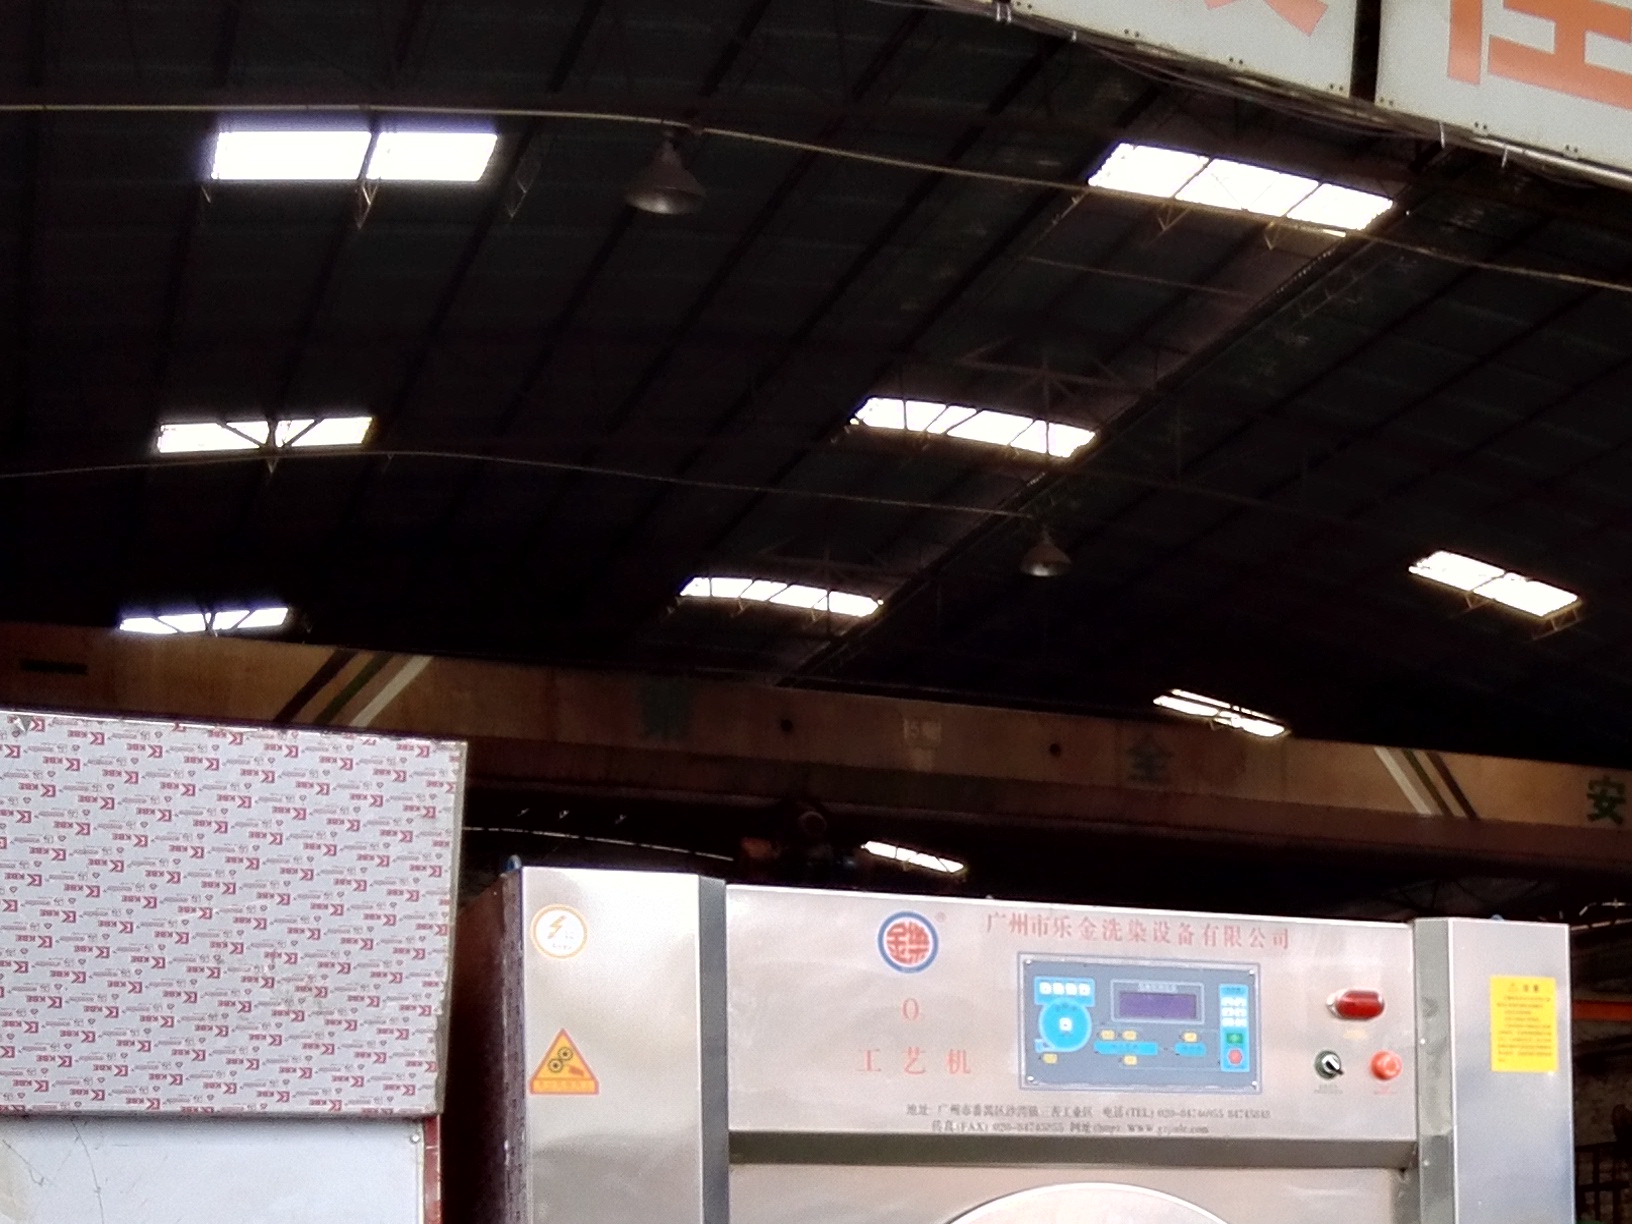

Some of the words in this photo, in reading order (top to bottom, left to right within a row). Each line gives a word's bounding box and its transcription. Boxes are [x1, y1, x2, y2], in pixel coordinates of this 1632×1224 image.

[1586, 774, 1627, 826] 安
[986, 912, 1290, 949] 广州市乐金洗染设备有限公司
[858, 1046, 972, 1075] 工艺机
